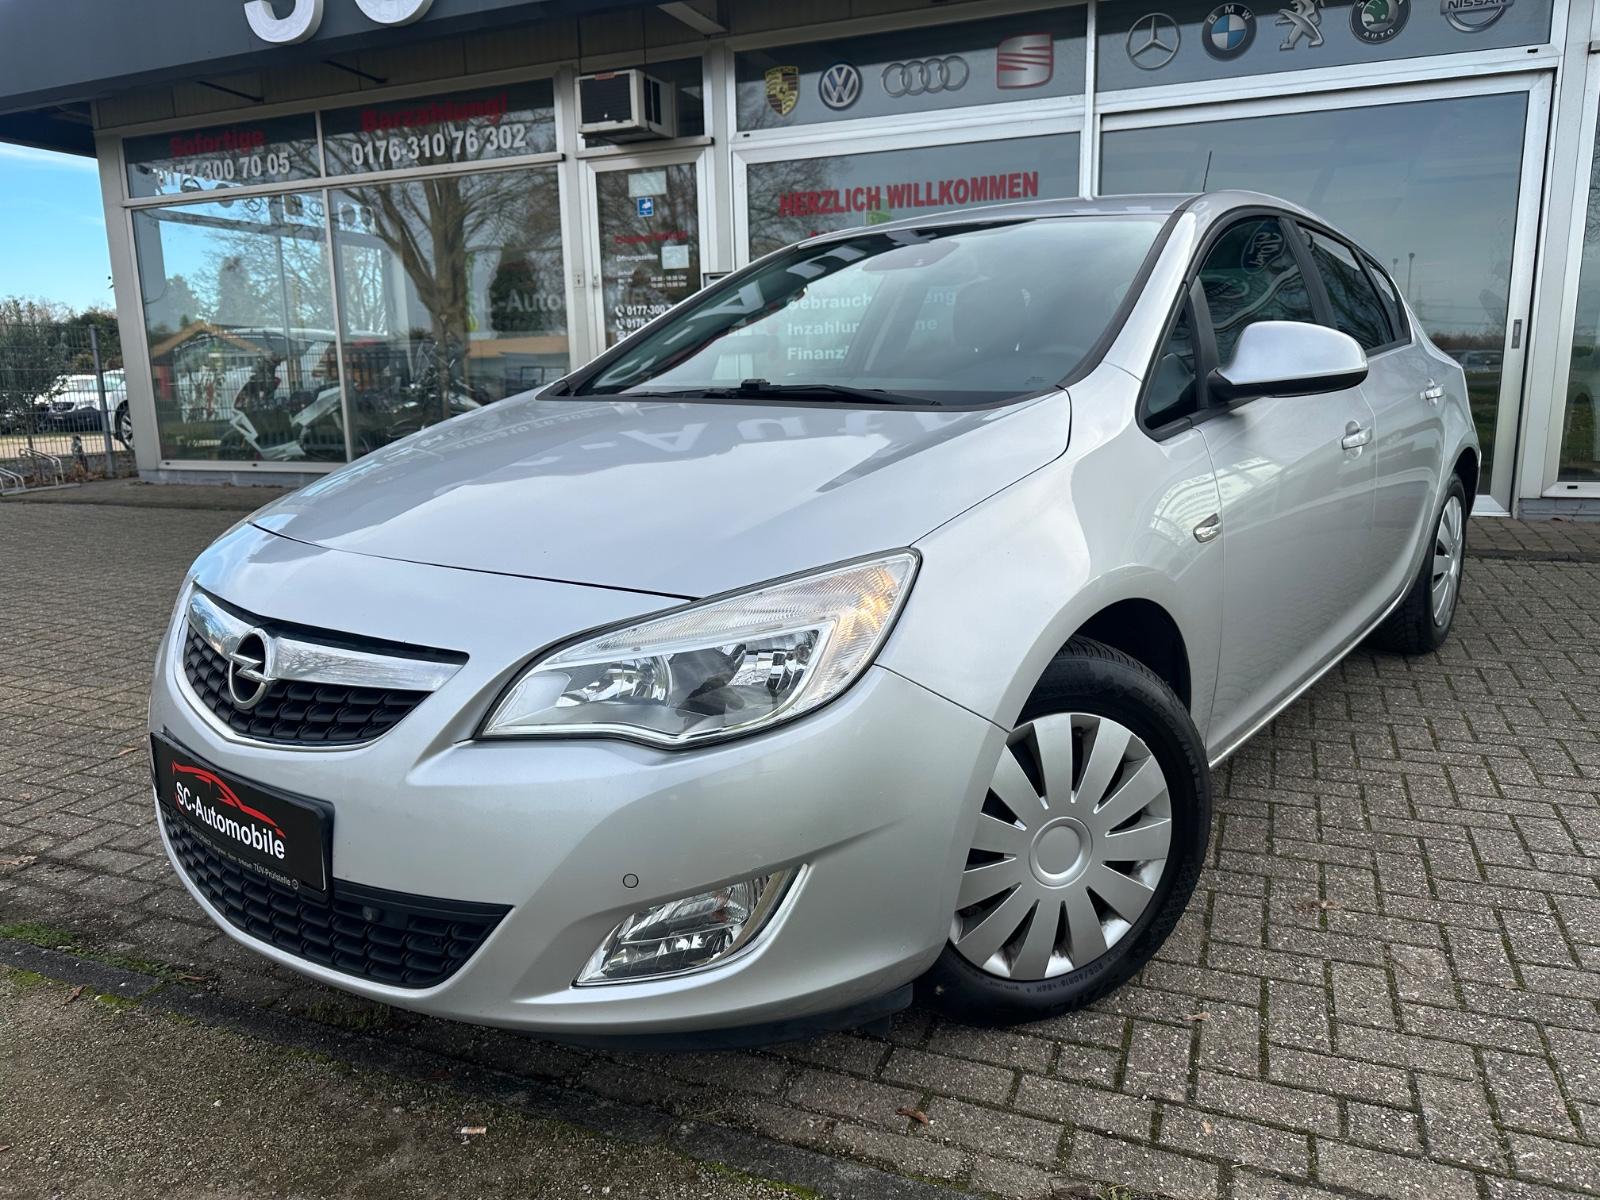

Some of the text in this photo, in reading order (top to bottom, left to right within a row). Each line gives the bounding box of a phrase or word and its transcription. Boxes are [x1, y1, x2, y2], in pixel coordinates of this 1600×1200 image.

[1207, 5, 1252, 25] BMW
[1363, 28, 1394, 39] AUTO
[170, 130, 265, 158] Sofortige
[352, 123, 527, 166] 0176-310 76 302
[239, 155, 262, 178] 70
[267, 151, 291, 174] 05
[779, 171, 1039, 217] HERZLICH WILLKOMMEN
[176, 781, 286, 860] SC-Automobile
